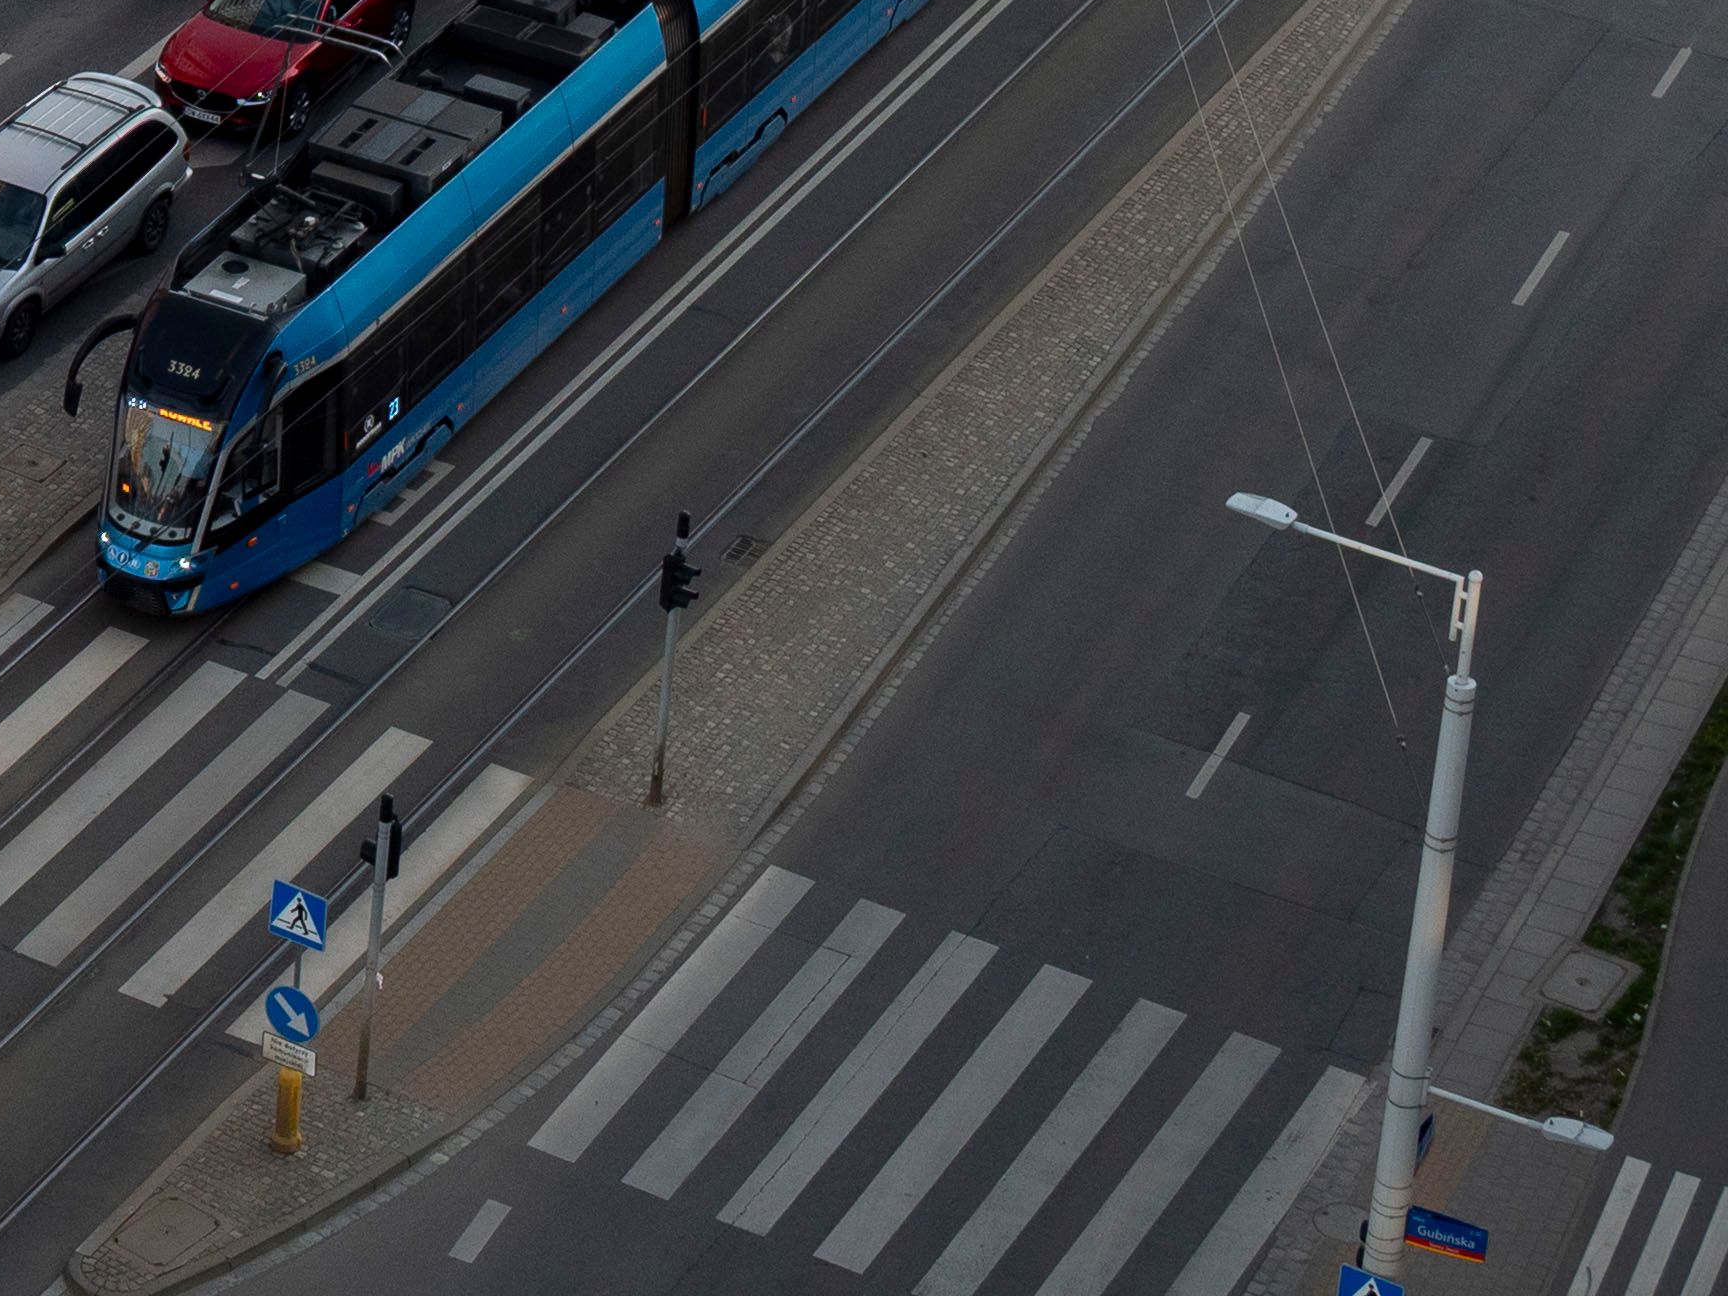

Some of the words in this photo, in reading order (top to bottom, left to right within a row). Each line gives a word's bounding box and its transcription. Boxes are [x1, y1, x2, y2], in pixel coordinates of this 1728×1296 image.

[167, 359, 200, 379] 3324
[388, 397, 399, 420] 23
[381, 440, 404, 473] MPK
[1417, 1224, 1476, 1250] Gubińska
